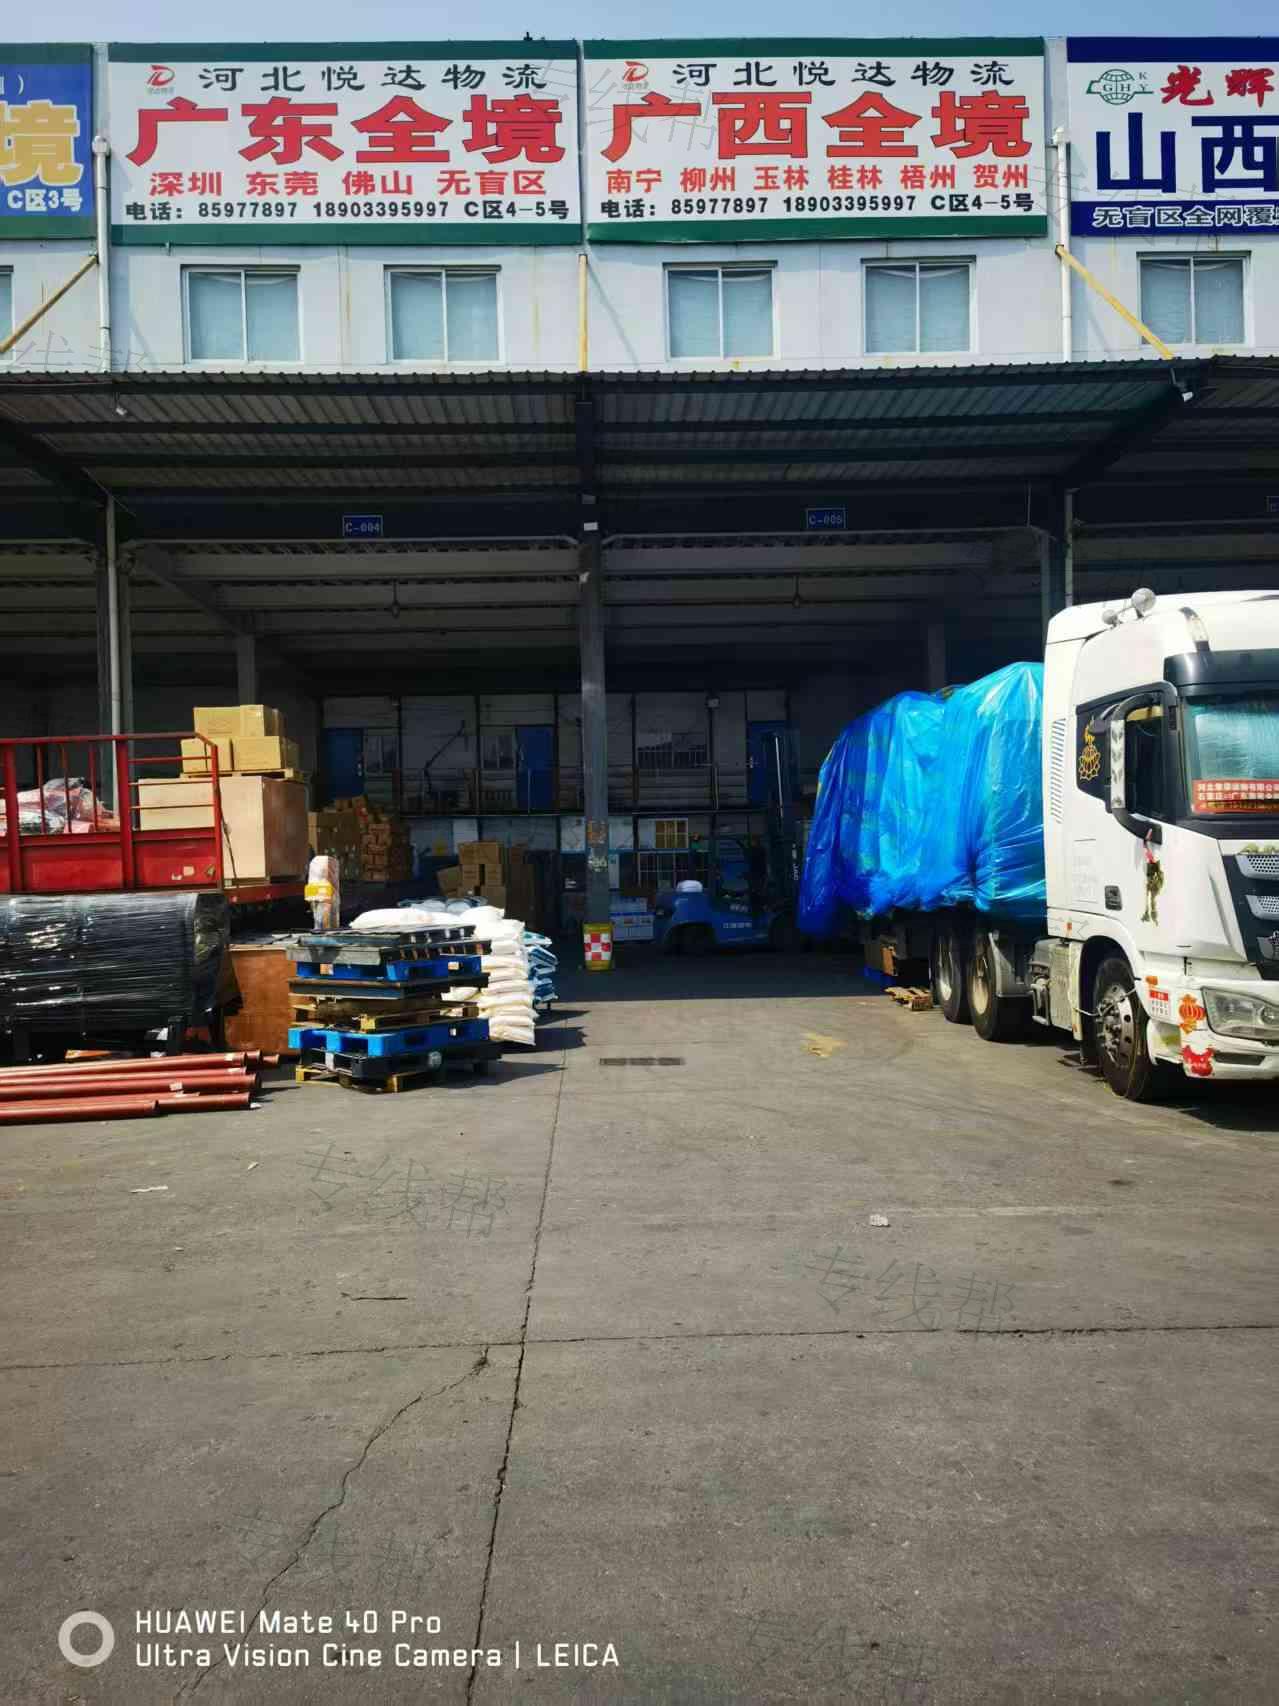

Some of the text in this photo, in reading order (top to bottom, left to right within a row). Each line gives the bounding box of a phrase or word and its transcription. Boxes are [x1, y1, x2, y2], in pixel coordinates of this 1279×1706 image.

[199, 64, 547, 92] 河北悦达物流
[673, 61, 1014, 87] 河北悦达物流
[125, 92, 567, 167] 广东全境
[600, 89, 1033, 163] 广西全境
[150, 170, 547, 197] 深圳 东莞 佛山 无盲区
[605, 163, 1028, 194] 南宁 柳州 玉林 桂林 梧州 贺州
[7, 187, 83, 212] C区3号
[198, 201, 298, 218] 85977897
[313, 200, 449, 218] 18903395997
[671, 197, 769, 215] 85977897
[783, 194, 917, 213] 18903395997
[1092, 204, 1279, 228] 无盲区全网覆
